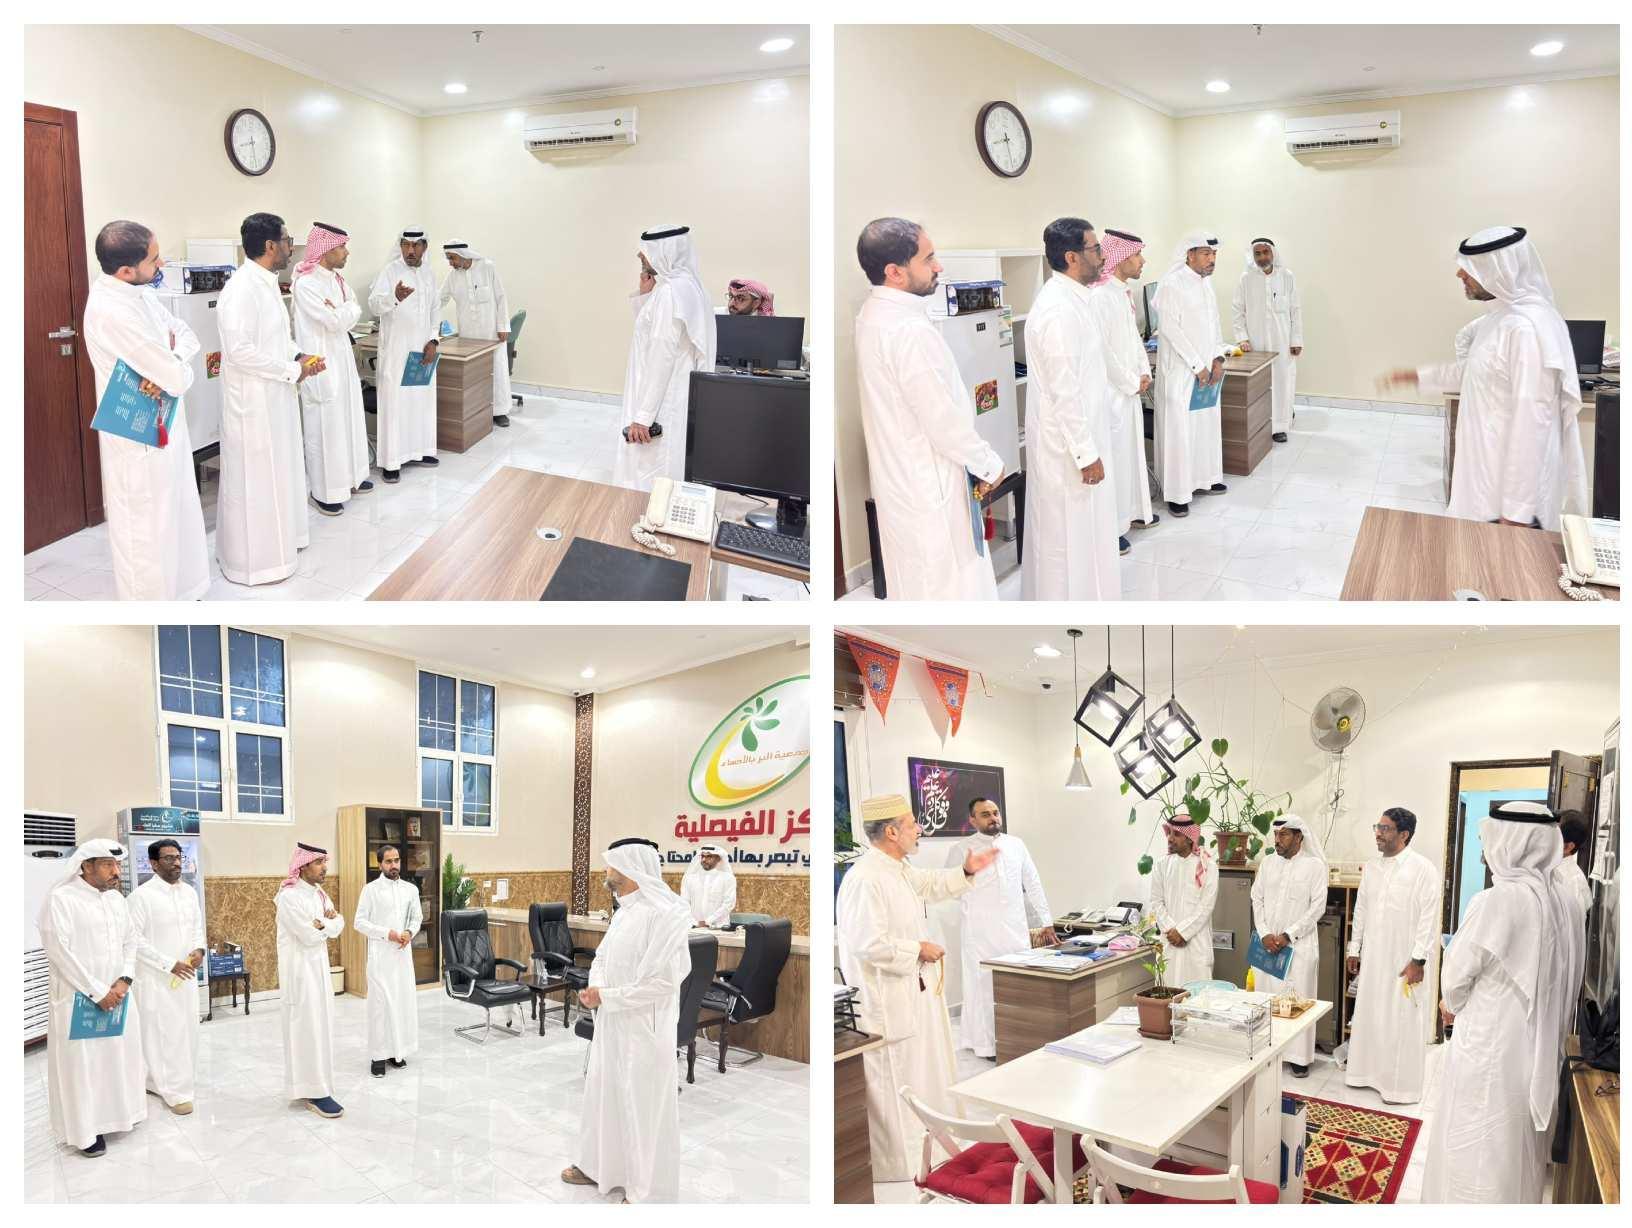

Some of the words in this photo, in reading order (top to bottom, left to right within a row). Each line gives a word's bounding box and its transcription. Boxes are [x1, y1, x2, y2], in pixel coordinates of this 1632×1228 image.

[675, 809, 775, 843] الفيصلية
[779, 809, 810, 844] كز
[764, 849, 800, 868] تبصر
